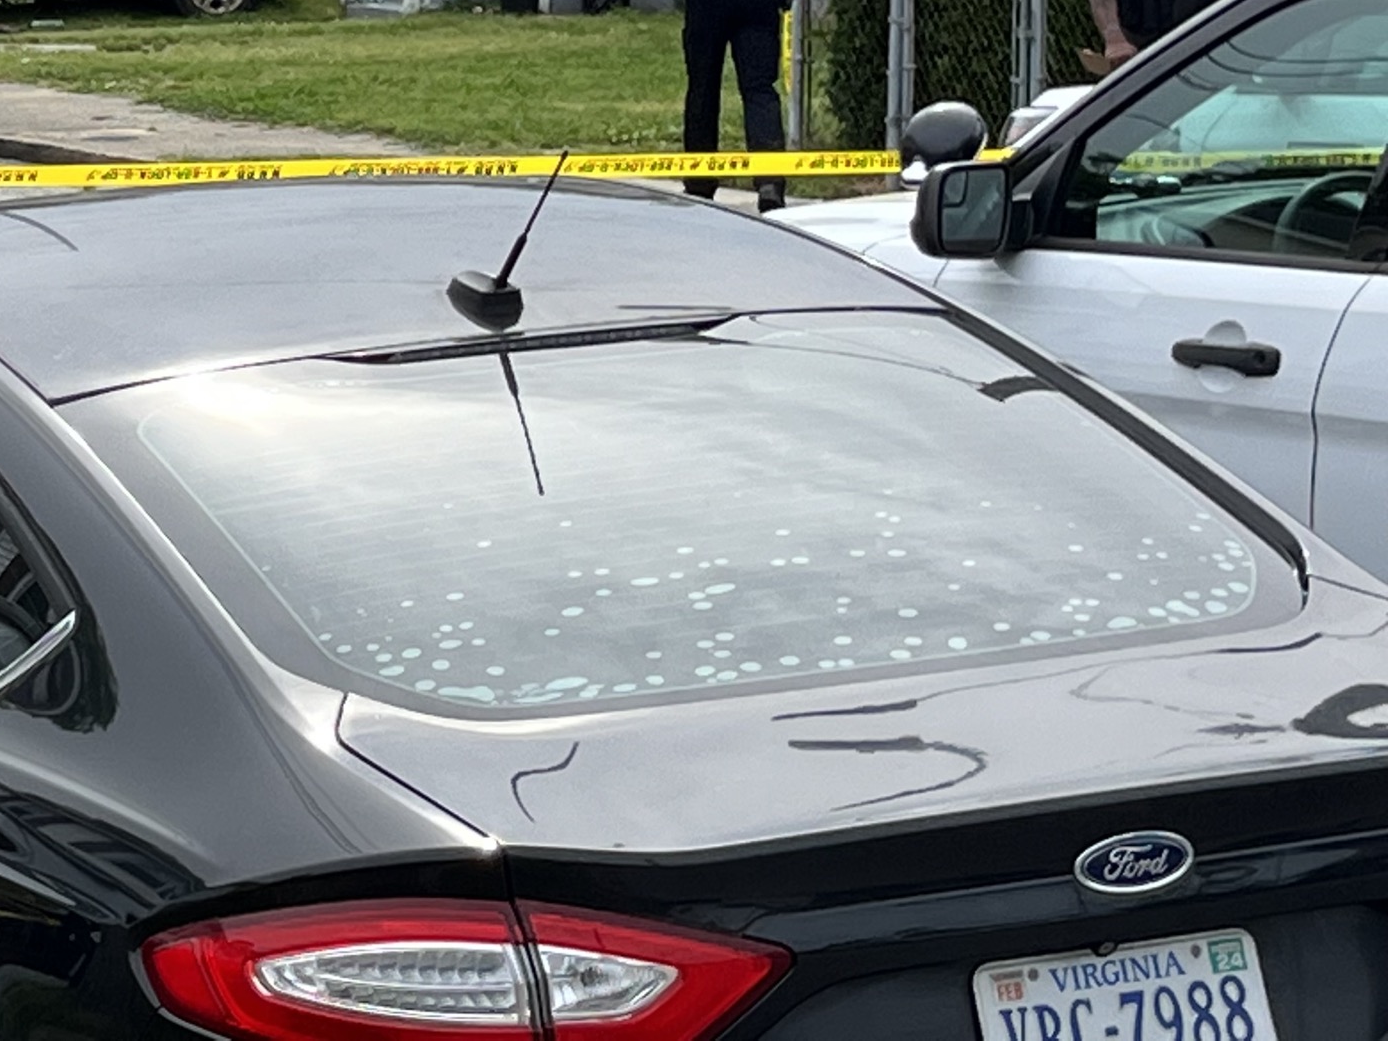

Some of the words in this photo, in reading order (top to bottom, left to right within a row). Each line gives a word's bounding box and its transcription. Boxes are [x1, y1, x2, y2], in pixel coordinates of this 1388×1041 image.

[1103, 844, 1170, 881] Ford
[1048, 950, 1187, 993] VIRGINIA
[1216, 952, 1244, 970] 24
[997, 981, 1024, 1002] FEB
